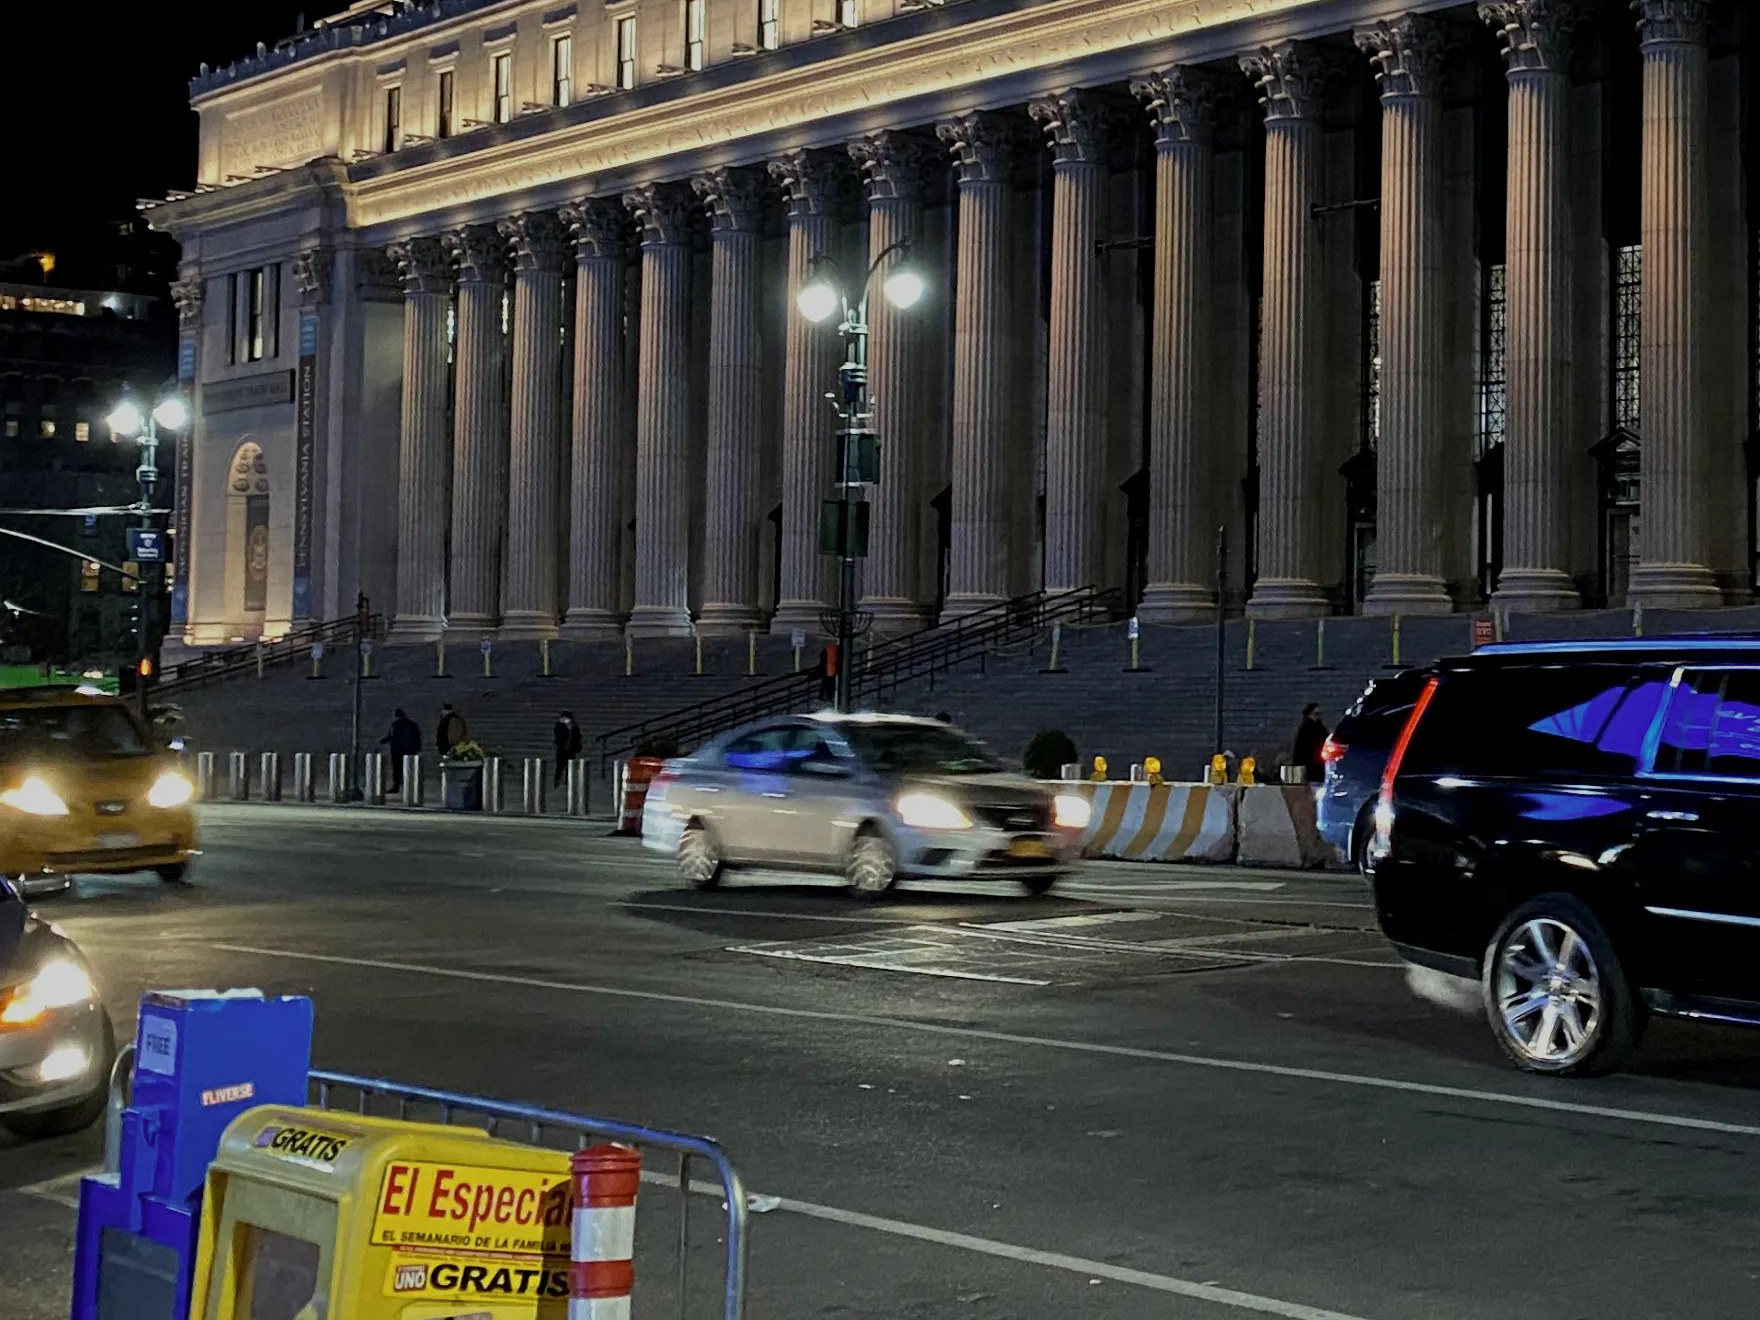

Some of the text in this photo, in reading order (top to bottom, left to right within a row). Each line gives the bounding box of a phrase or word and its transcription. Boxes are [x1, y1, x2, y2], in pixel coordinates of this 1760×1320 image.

[146, 1033, 171, 1056] FREE
[271, 1127, 347, 1162] GRATIS
[382, 1165, 419, 1216] El
[382, 1230, 395, 1242] EL
[400, 1230, 471, 1247] SEMANARIO
[474, 1235, 490, 1248] DE
[494, 1237, 509, 1249] LA
[512, 1238, 558, 1252] FAMILIA
[394, 1263, 571, 1297] UNO GRATIS
